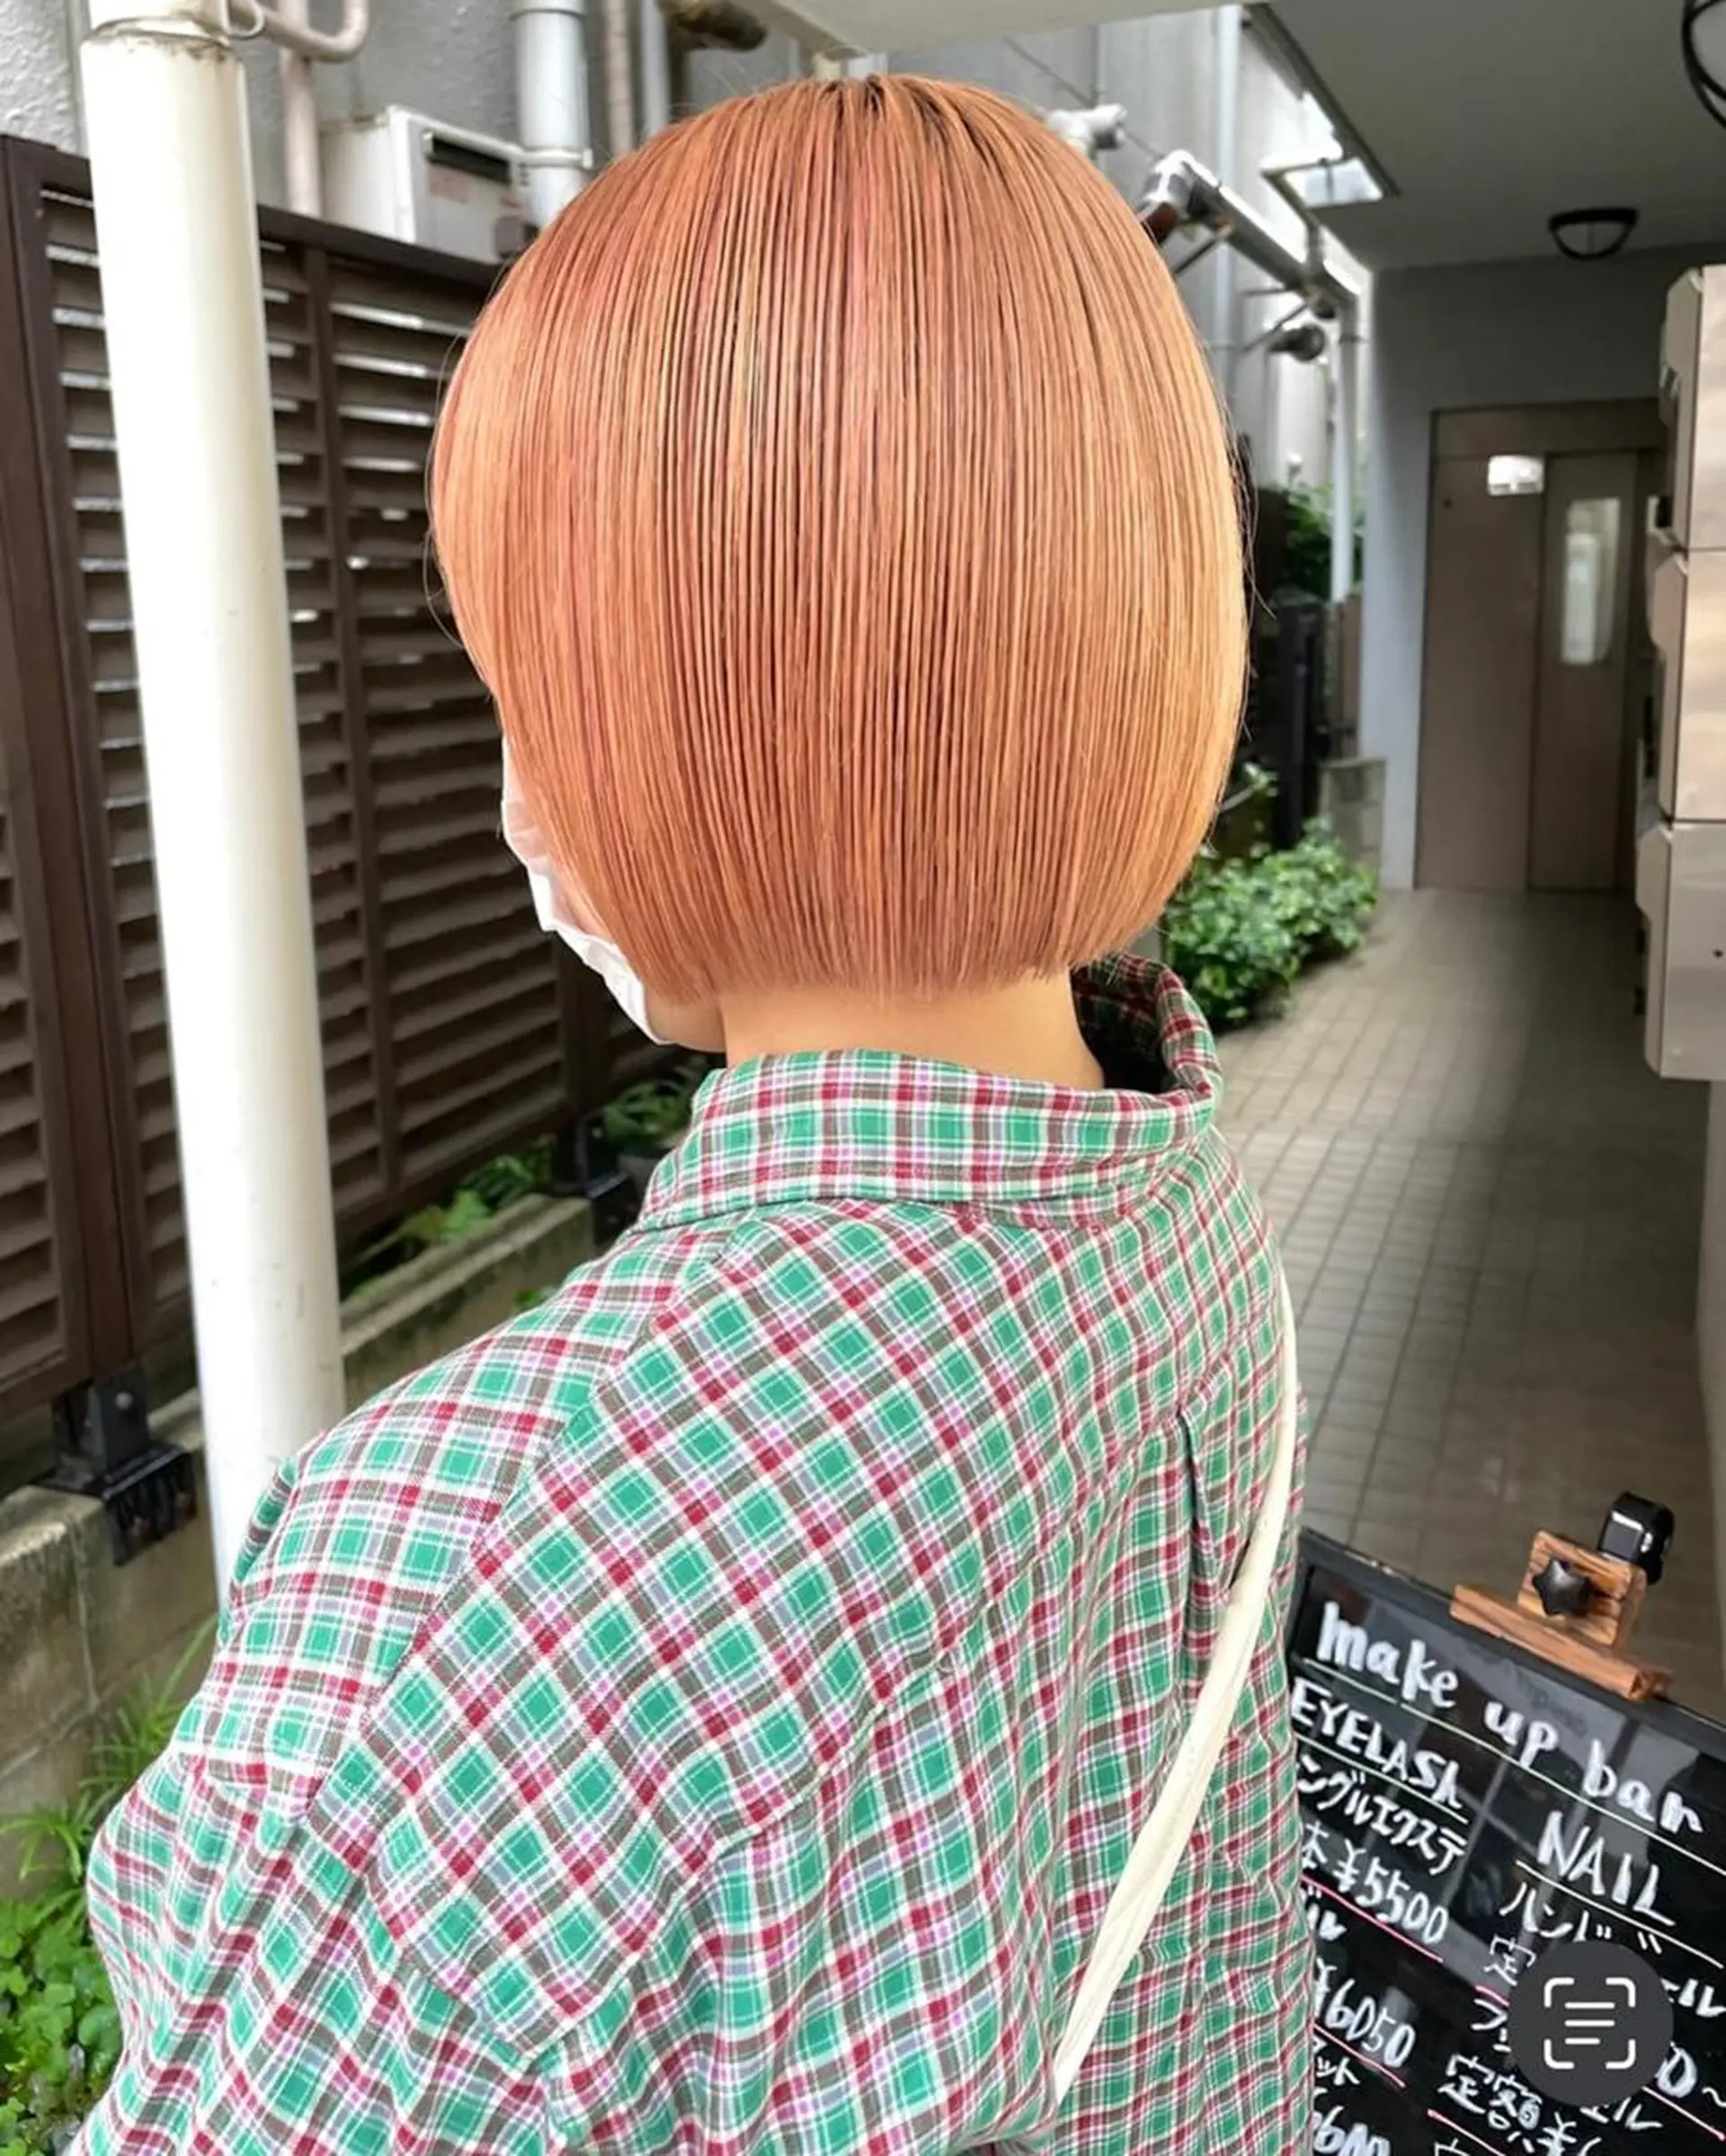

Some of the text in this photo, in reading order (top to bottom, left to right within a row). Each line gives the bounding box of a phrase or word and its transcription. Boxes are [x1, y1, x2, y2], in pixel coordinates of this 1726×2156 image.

[1316, 1601, 1458, 1708] make
[1484, 1701, 1559, 1769] up
[1536, 1810, 1676, 1927] NAIL
